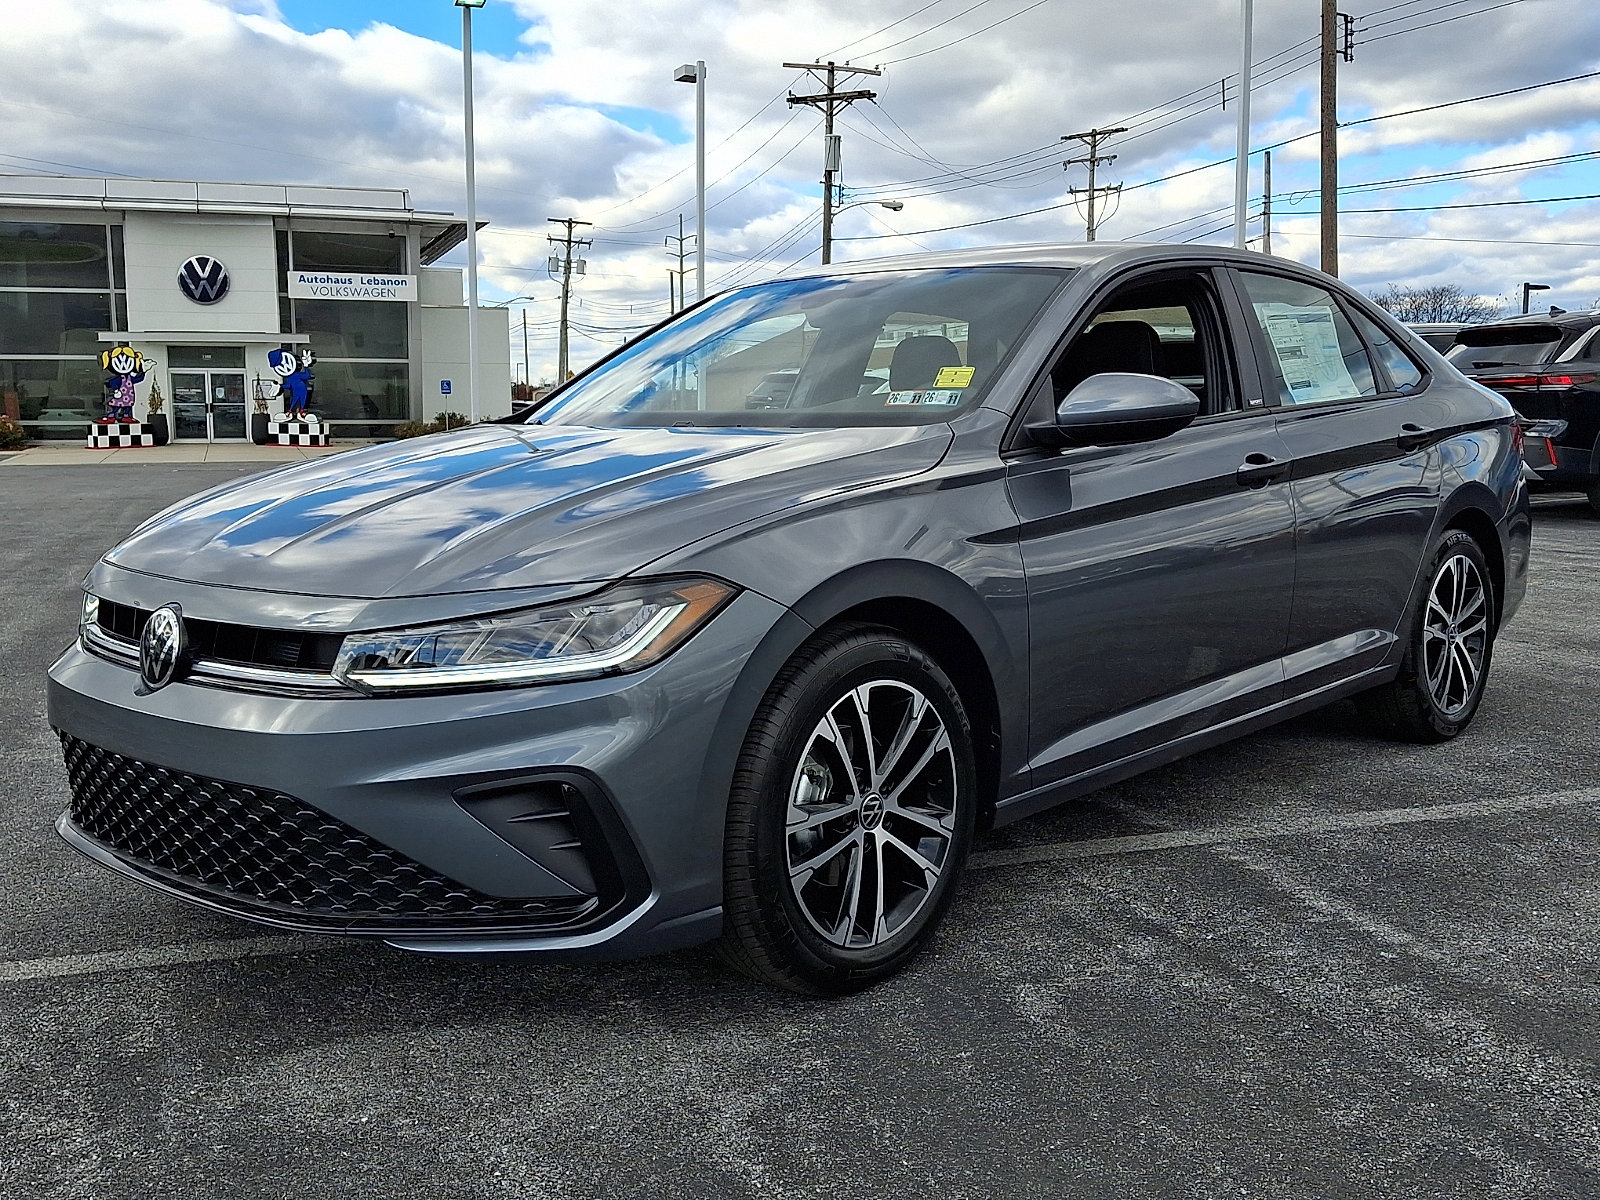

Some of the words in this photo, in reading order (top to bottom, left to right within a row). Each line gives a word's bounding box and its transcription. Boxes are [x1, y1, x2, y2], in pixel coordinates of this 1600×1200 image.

[178, 255, 230, 304] VW
[298, 275, 353, 285] Autohaus
[360, 276, 408, 287] Lebanon
[310, 286, 397, 298] VOLKSWAGEN
[888, 393, 900, 404] 26
[910, 393, 922, 404] 11
[924, 392, 936, 403] 26
[947, 393, 959, 404] 11
